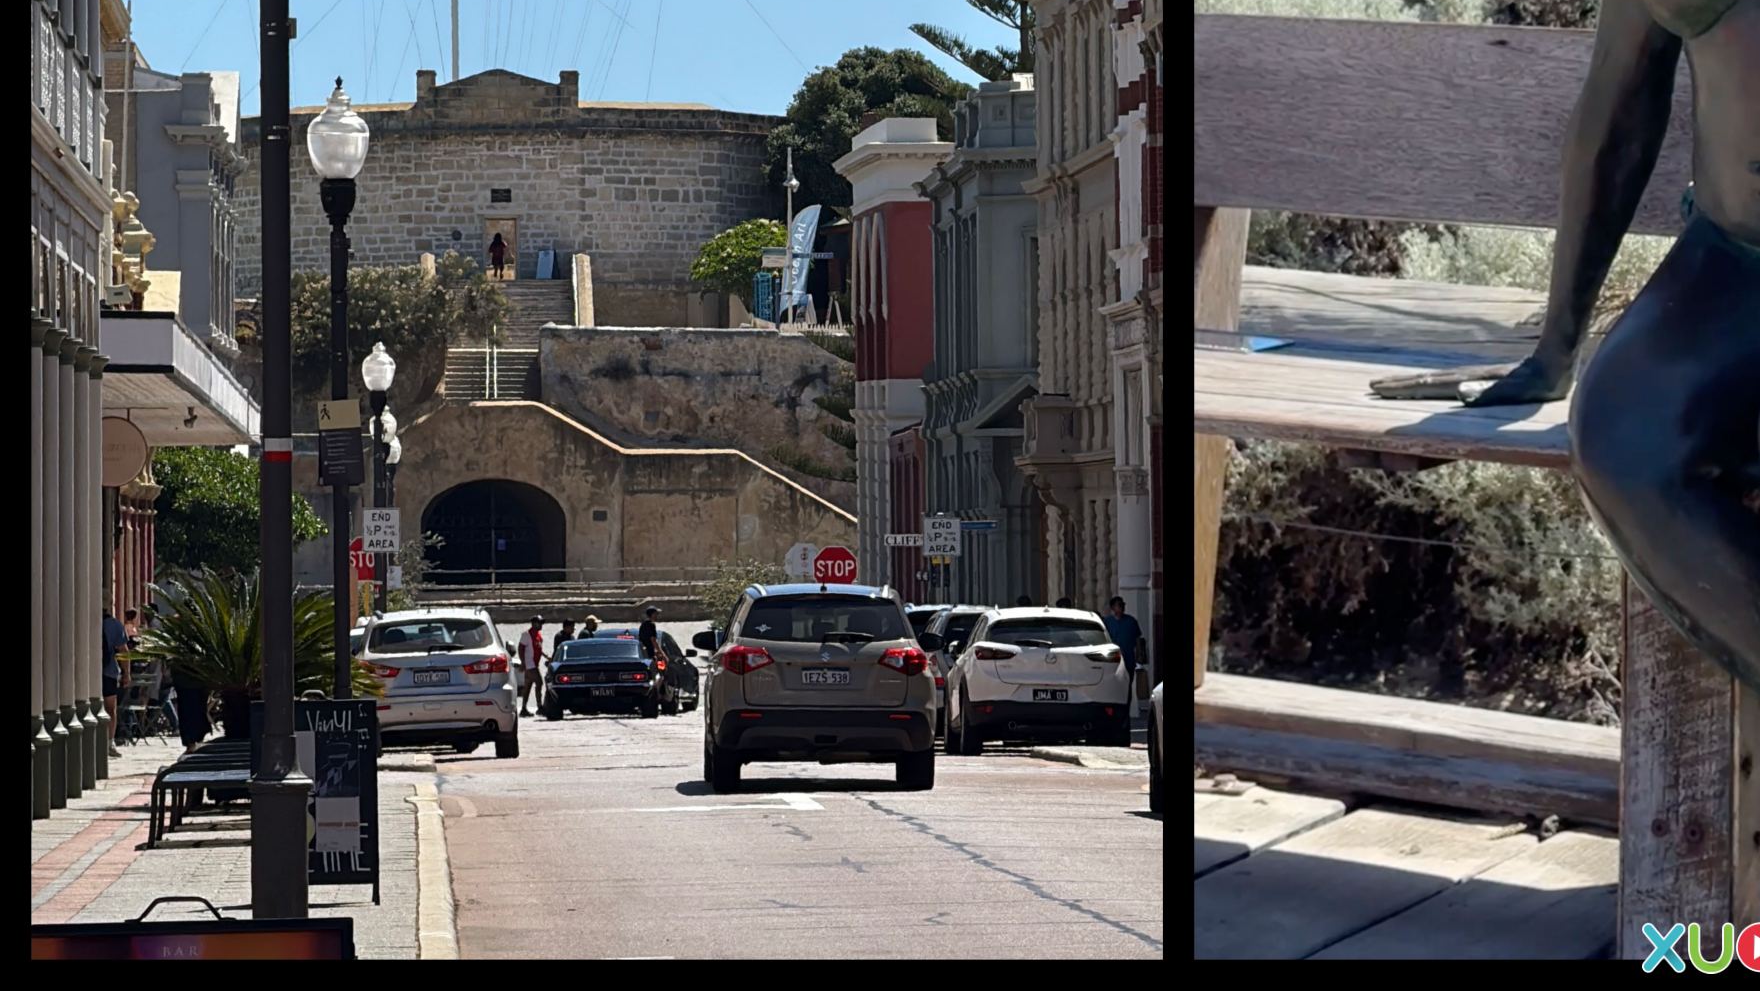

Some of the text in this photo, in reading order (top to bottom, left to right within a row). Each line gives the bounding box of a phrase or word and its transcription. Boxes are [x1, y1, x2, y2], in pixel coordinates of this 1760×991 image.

[371, 512, 391, 522] END
[931, 520, 952, 530] END
[368, 539, 395, 549] AREA
[885, 535, 920, 545] CLIFF
[928, 544, 956, 553] AREA
[349, 551, 376, 568] STO
[816, 560, 855, 577] STOP
[161, 945, 200, 958] BAR
